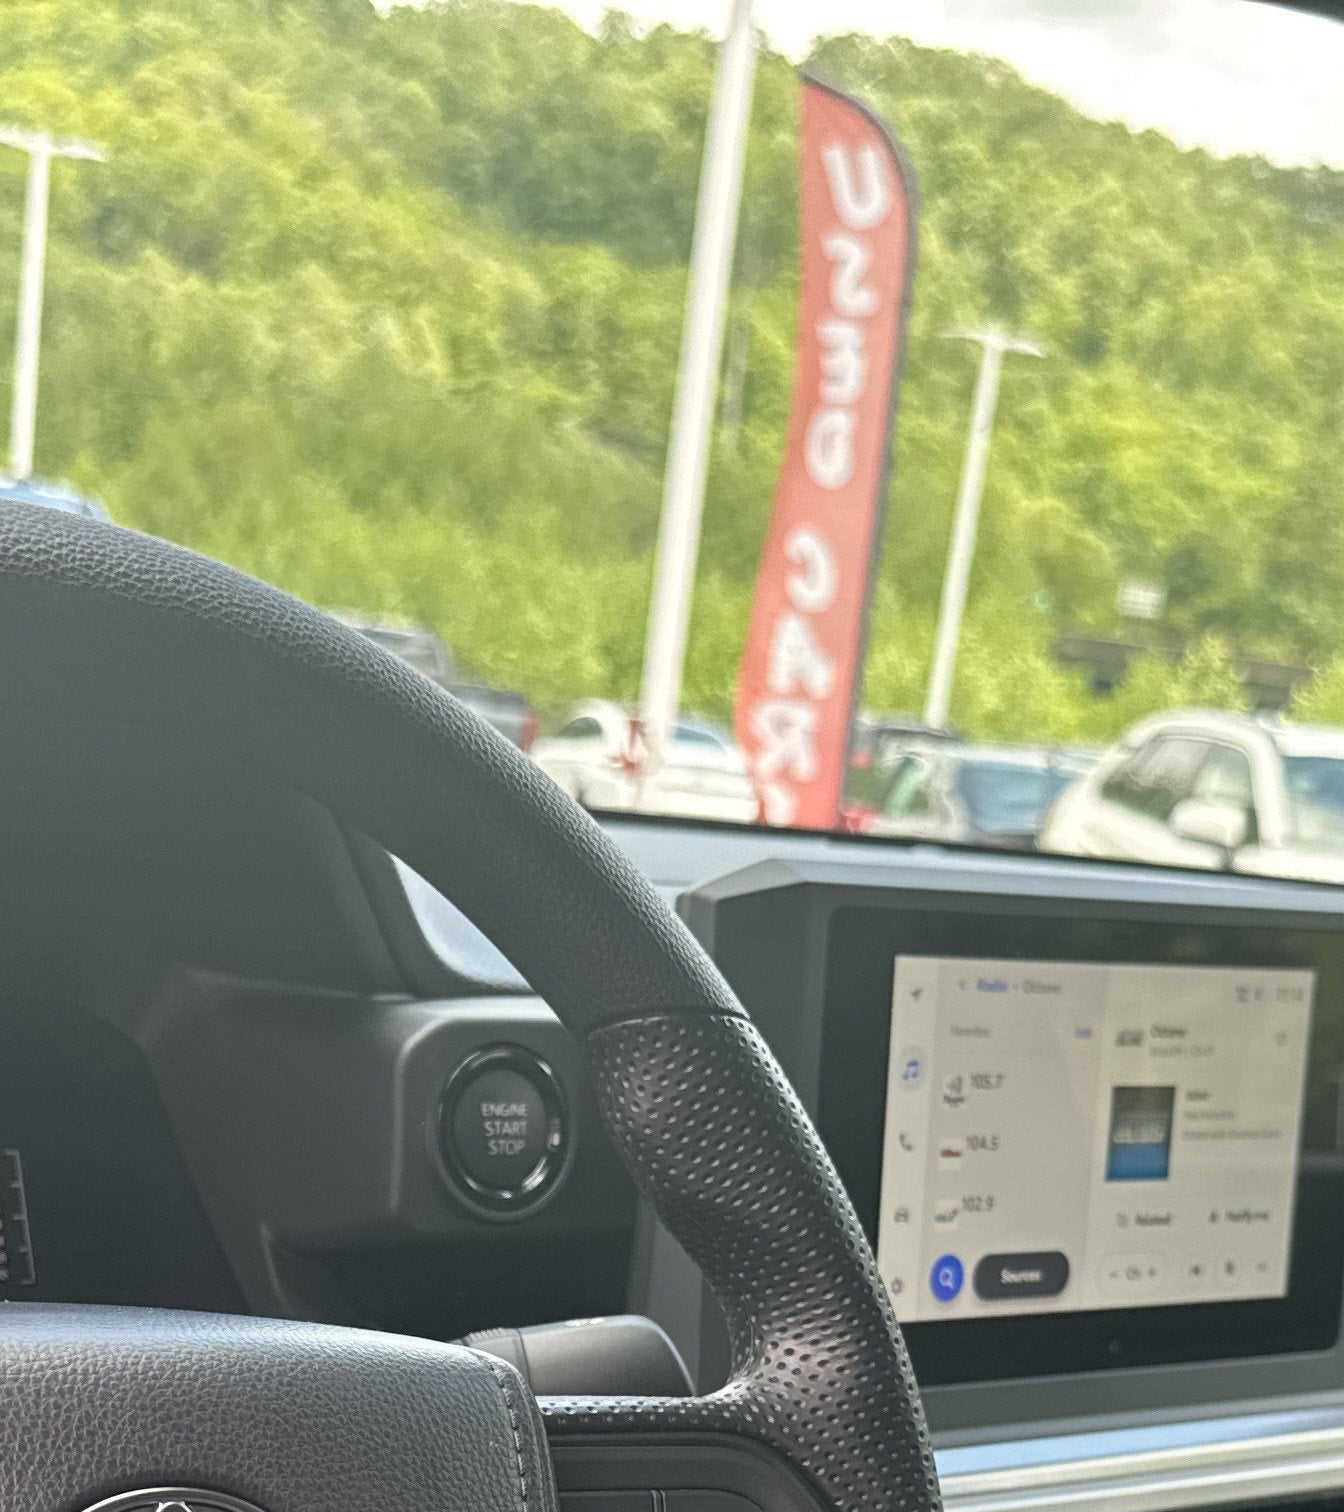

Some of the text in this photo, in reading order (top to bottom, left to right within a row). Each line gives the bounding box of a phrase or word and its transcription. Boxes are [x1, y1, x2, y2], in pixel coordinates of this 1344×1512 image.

[480, 1103, 527, 1118] ENGINE
[483, 1120, 527, 1137] START
[487, 1139, 525, 1155] STOP
